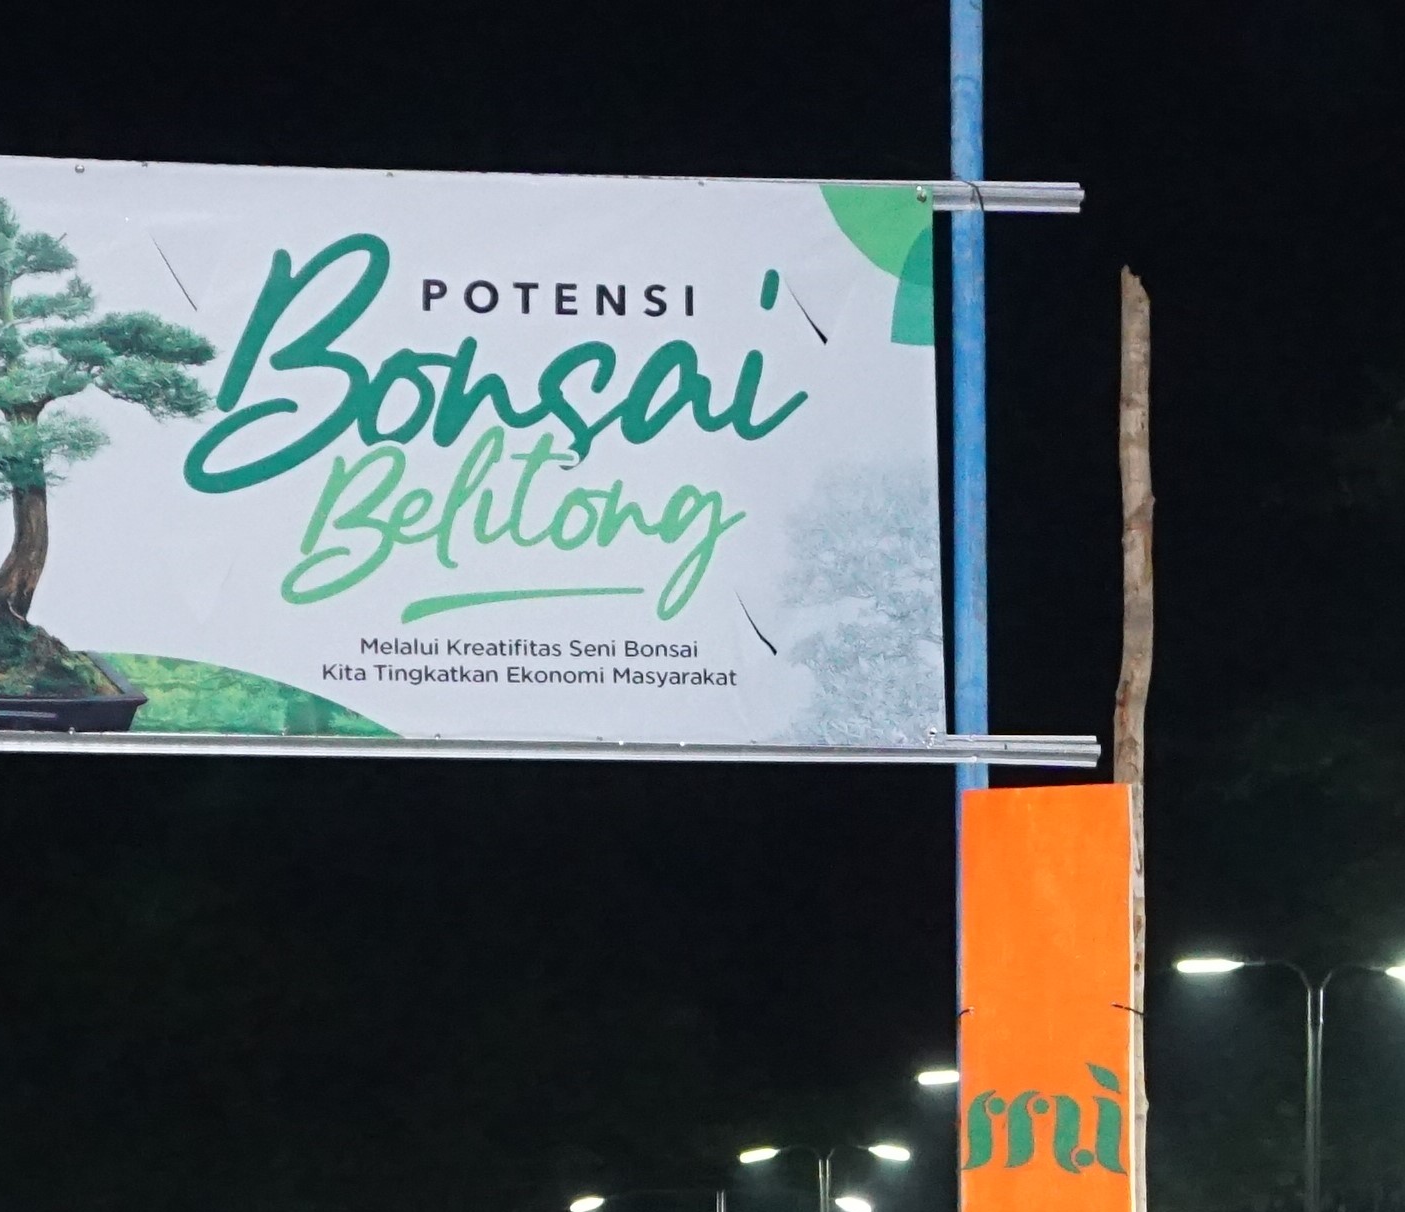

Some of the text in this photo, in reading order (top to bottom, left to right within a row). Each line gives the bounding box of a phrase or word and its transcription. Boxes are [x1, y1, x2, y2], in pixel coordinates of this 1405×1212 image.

[422, 278, 695, 317] POTENSI
[183, 232, 808, 494] Bonsai
[281, 427, 746, 621] Belitong
[360, 637, 698, 659] Melalui Kreatifitas Seni Bonsai
[322, 663, 738, 688] Kita Tingkatkan Ekonomi Masyarakat
